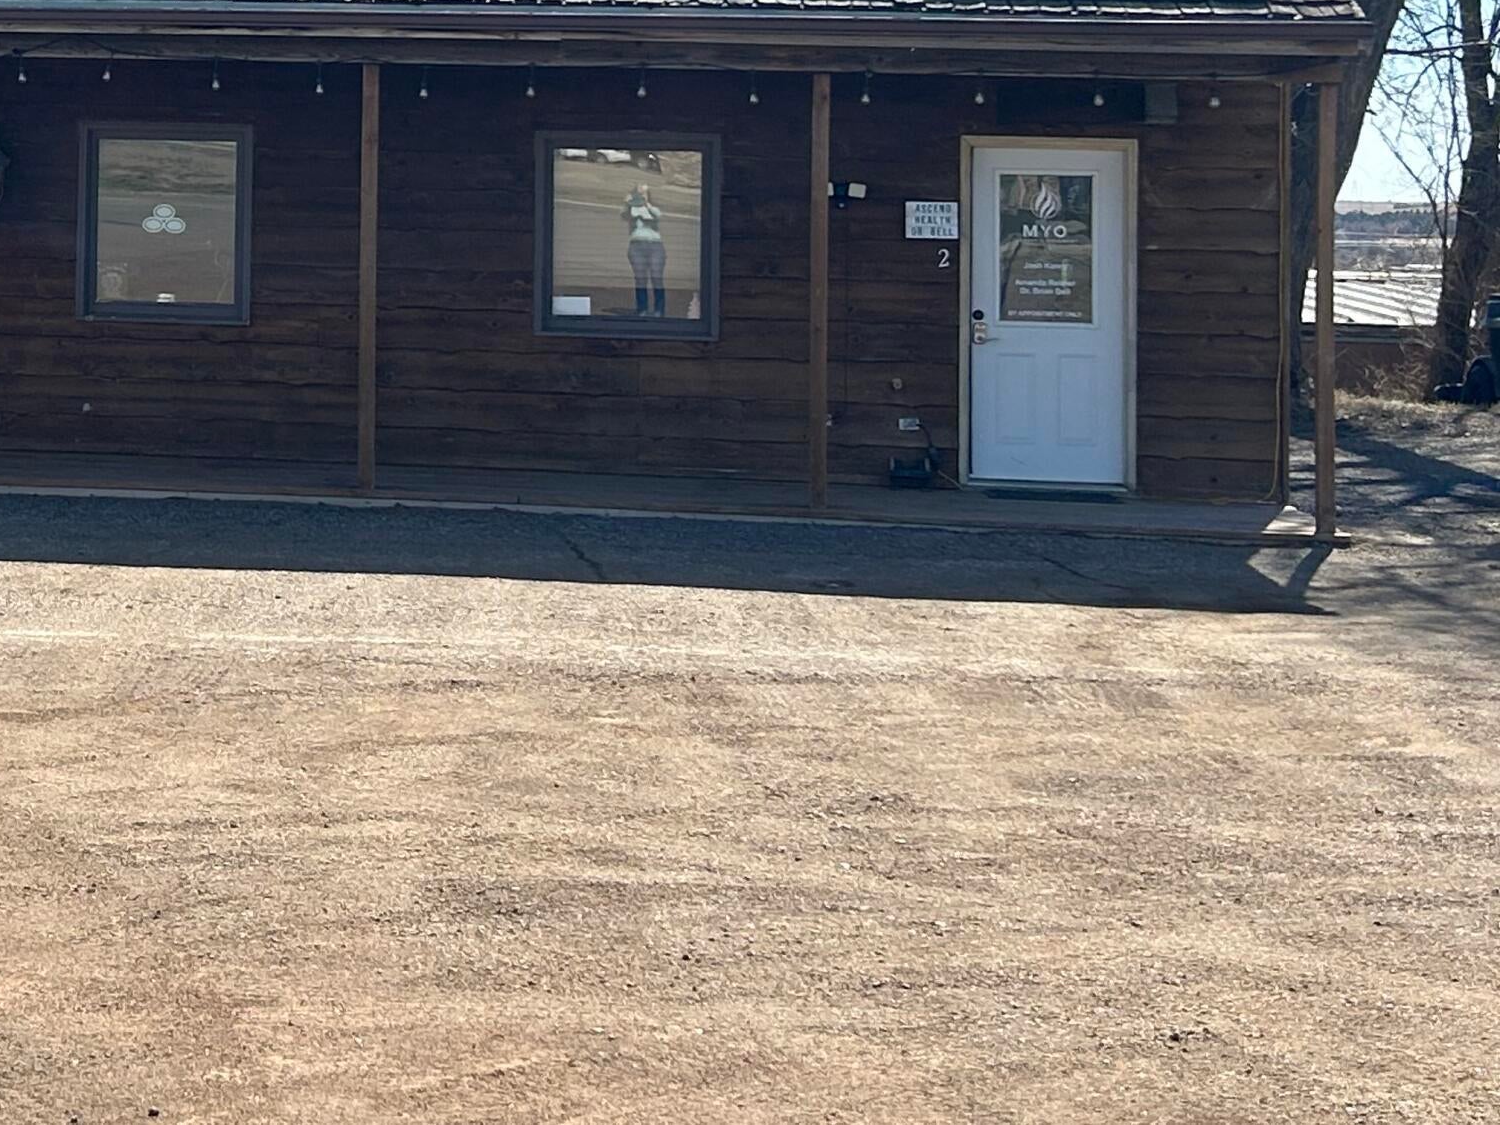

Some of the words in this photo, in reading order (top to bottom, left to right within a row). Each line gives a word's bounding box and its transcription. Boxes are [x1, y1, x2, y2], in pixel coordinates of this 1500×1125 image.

[914, 215, 951, 225] HEALTH
[1022, 224, 1068, 238] MYO
[937, 248, 951, 268] 2
